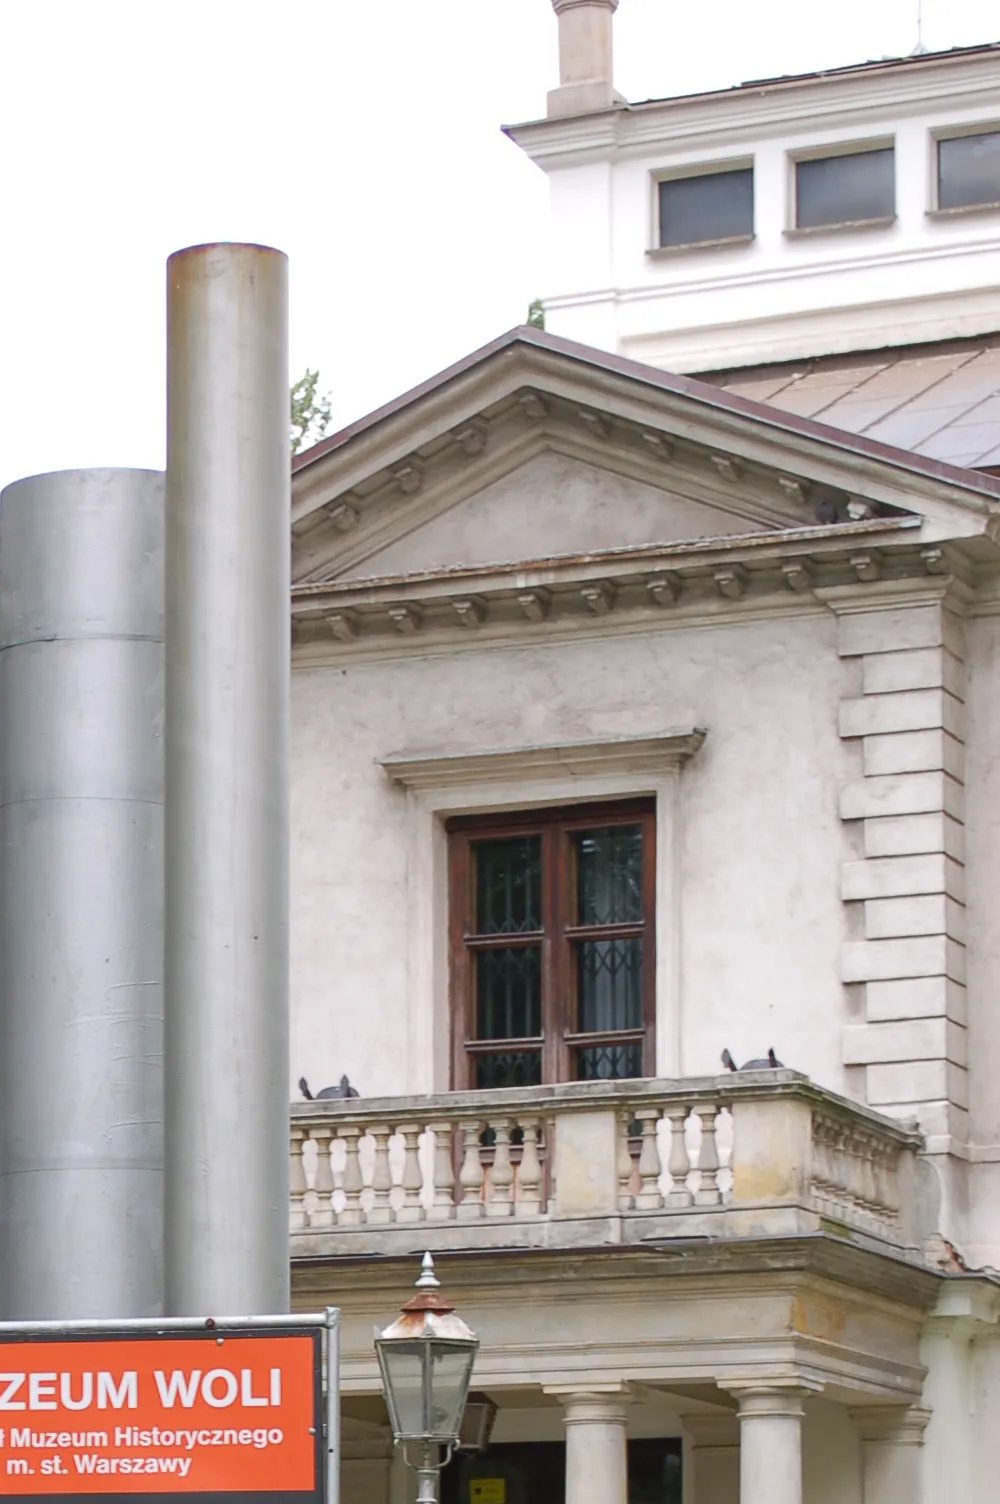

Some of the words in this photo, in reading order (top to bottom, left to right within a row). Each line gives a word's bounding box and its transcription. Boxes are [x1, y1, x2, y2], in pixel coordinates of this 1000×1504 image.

[153, 1367, 281, 1408] WOLI
[10, 1427, 109, 1448] Muzeum
[114, 1426, 284, 1450] Historycznego
[6, 1458, 35, 1475] m.
[40, 1454, 69, 1475] st.
[73, 1453, 192, 1477] Warszawy
